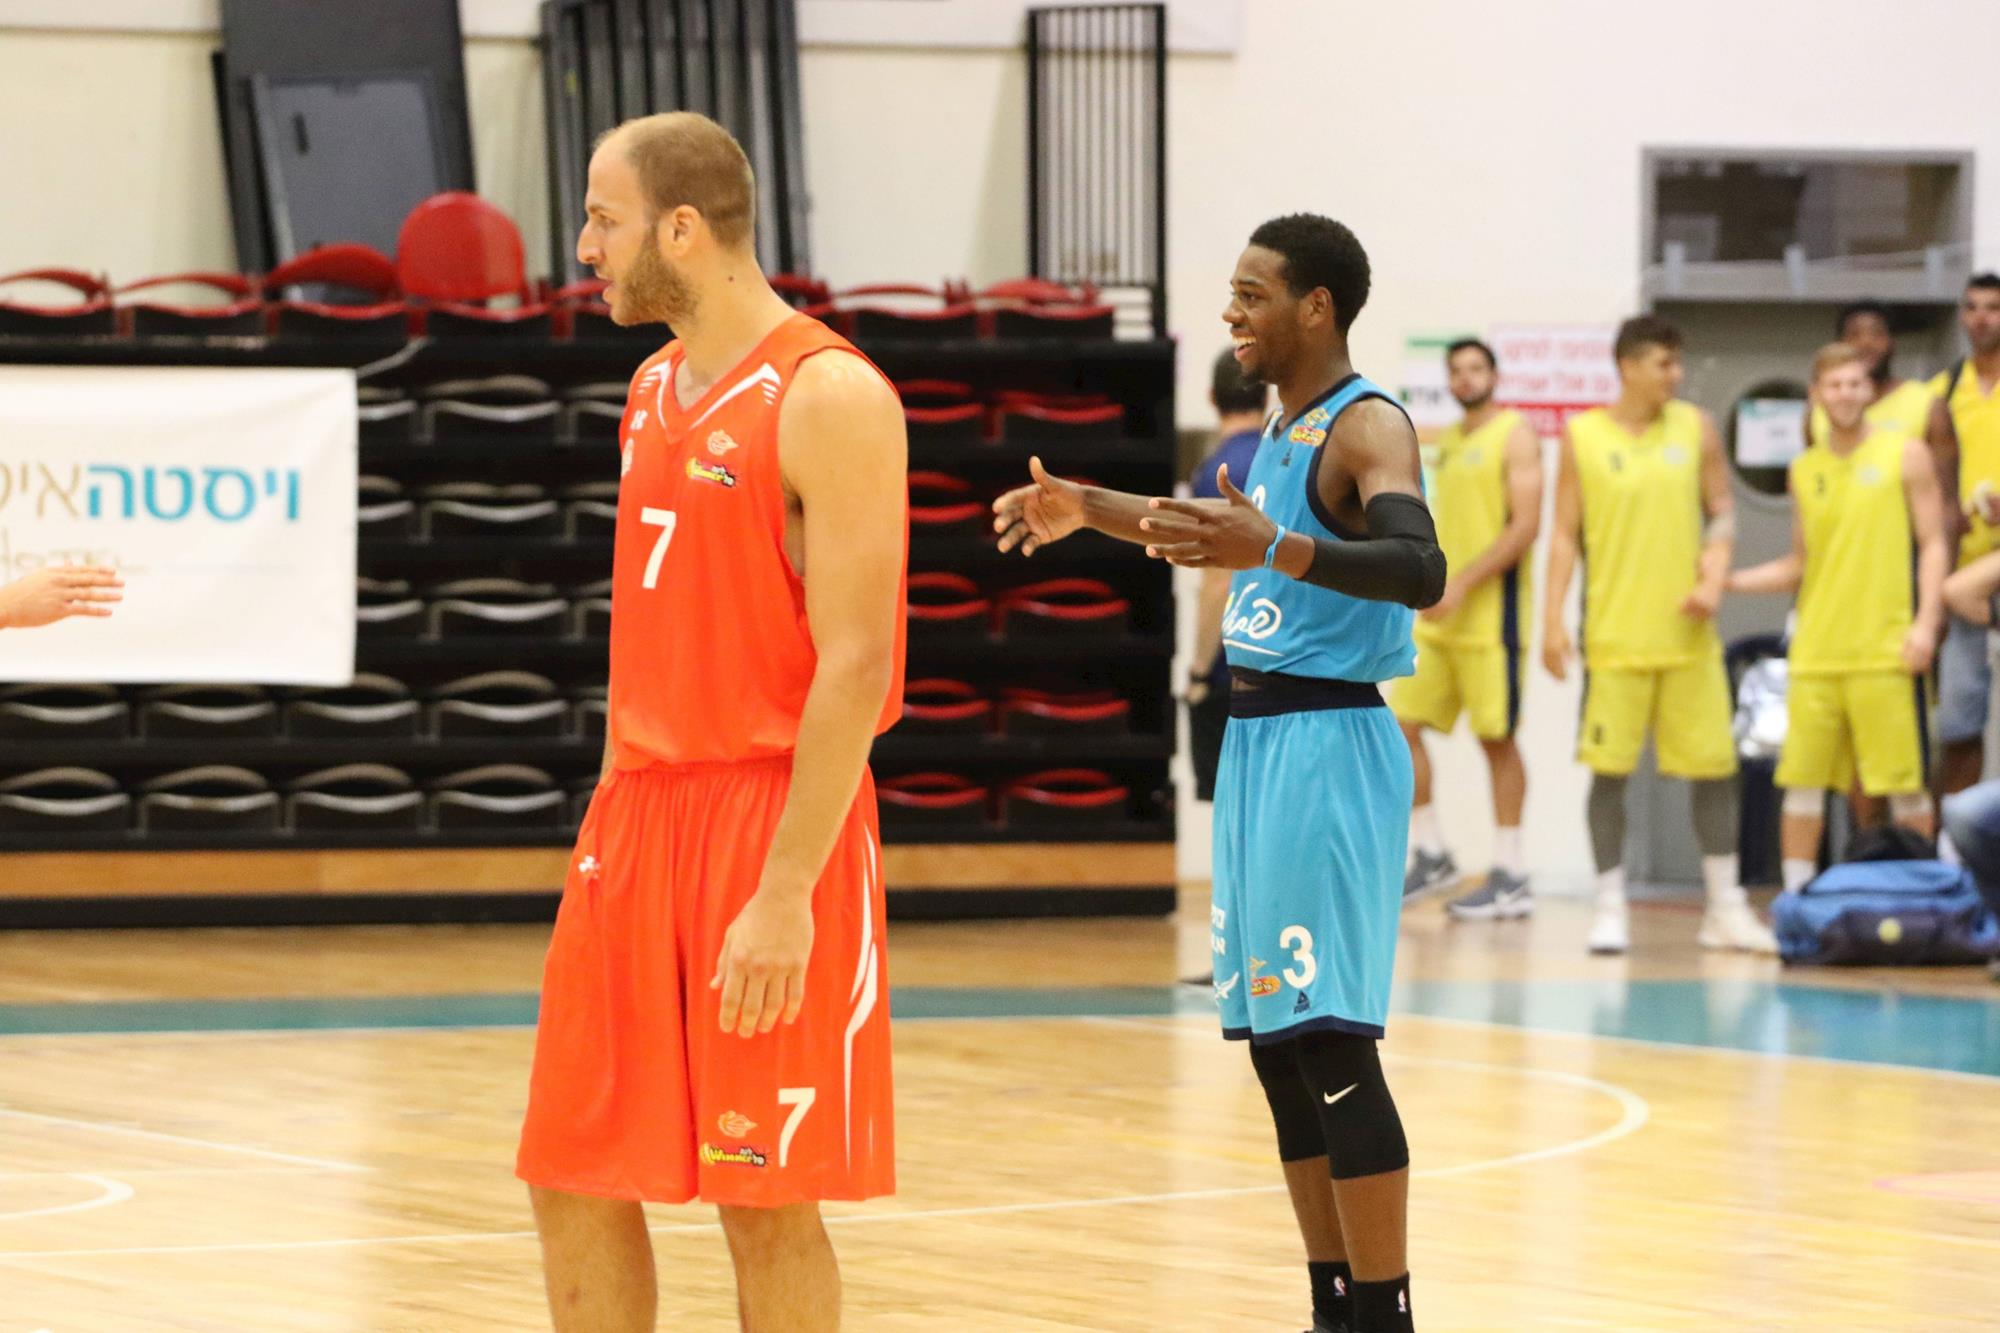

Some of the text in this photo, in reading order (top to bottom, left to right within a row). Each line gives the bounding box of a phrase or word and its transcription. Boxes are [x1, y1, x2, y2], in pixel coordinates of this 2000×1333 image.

[641, 506, 677, 590] 7
[1280, 925, 1316, 989] 3
[778, 1087, 816, 1168] 7
